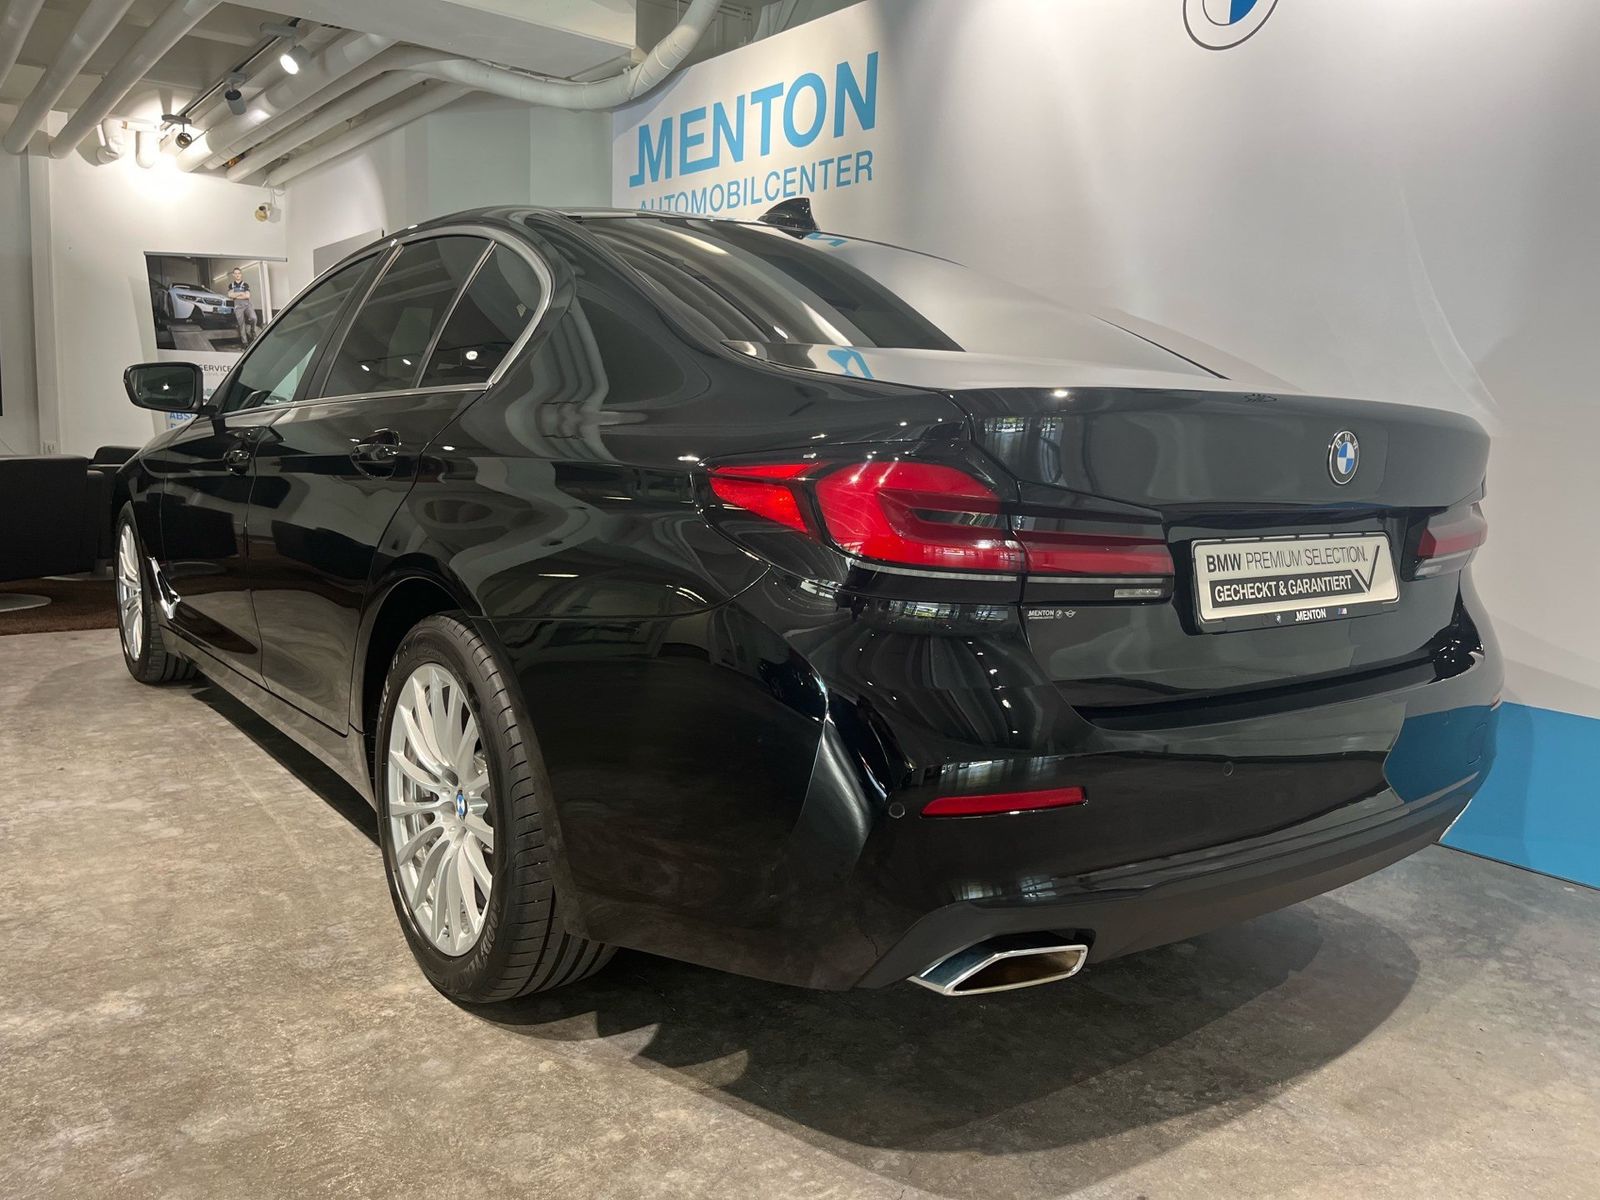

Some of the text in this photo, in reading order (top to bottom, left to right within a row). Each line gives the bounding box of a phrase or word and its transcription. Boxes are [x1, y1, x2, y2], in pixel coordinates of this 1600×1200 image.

[629, 51, 879, 188] MENTON
[1206, 553, 1242, 573] BMW
[1246, 549, 1303, 571] PREMIUM
[1215, 575, 1352, 602] GECHECKT & GARANTIERT
[1027, 609, 1055, 617] MENTON
[1295, 608, 1327, 622] MENTON
